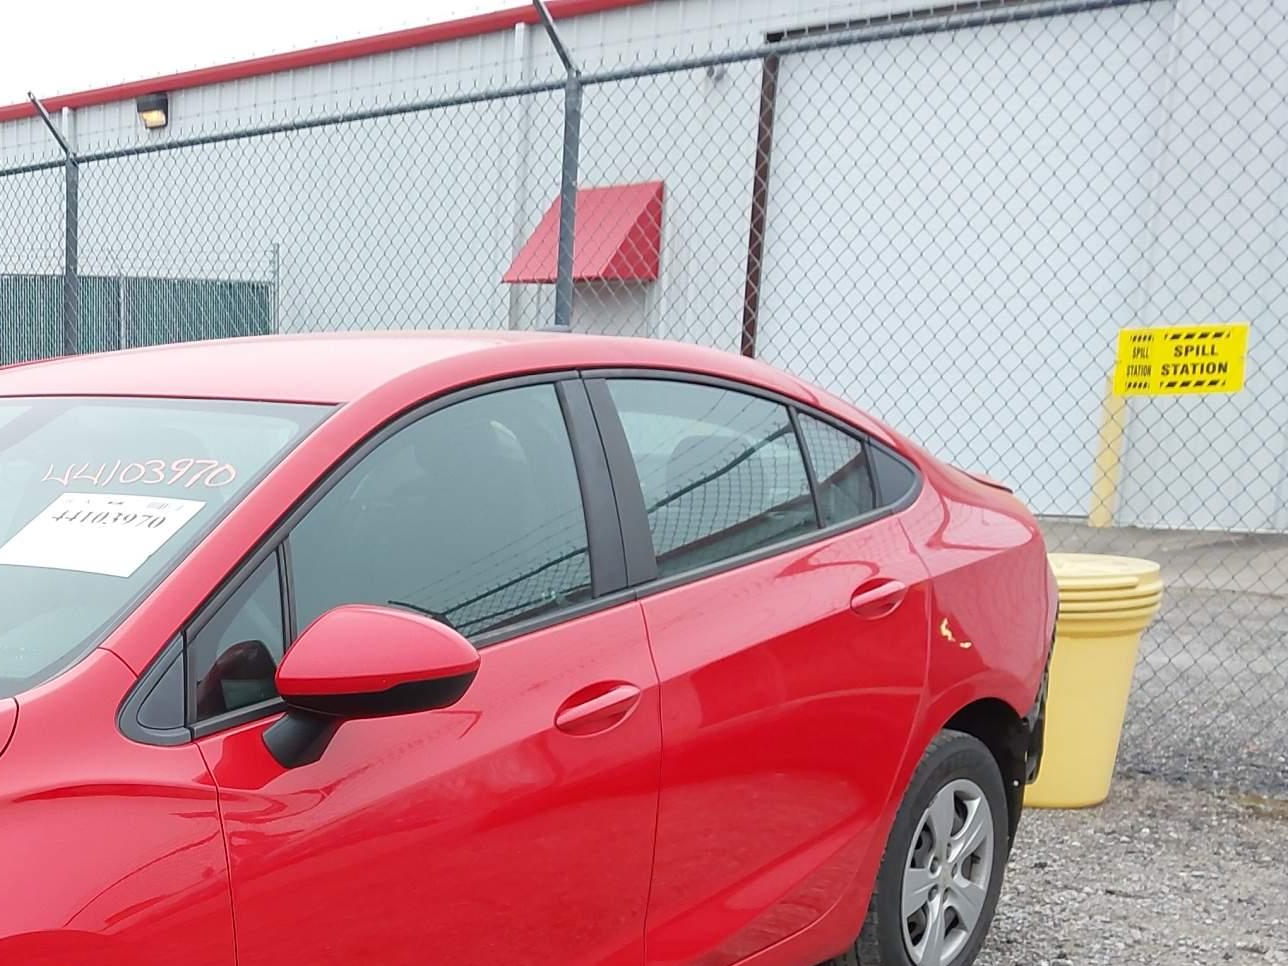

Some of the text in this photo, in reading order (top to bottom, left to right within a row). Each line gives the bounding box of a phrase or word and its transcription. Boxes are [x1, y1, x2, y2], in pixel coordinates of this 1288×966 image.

[1133, 346, 1149, 359] SPILL
[1174, 344, 1218, 357] SPILL
[1127, 365, 1151, 376] STATION
[1161, 362, 1227, 376] STATION
[42, 458, 236, 487] 44103970
[51, 509, 167, 529] 44103970
